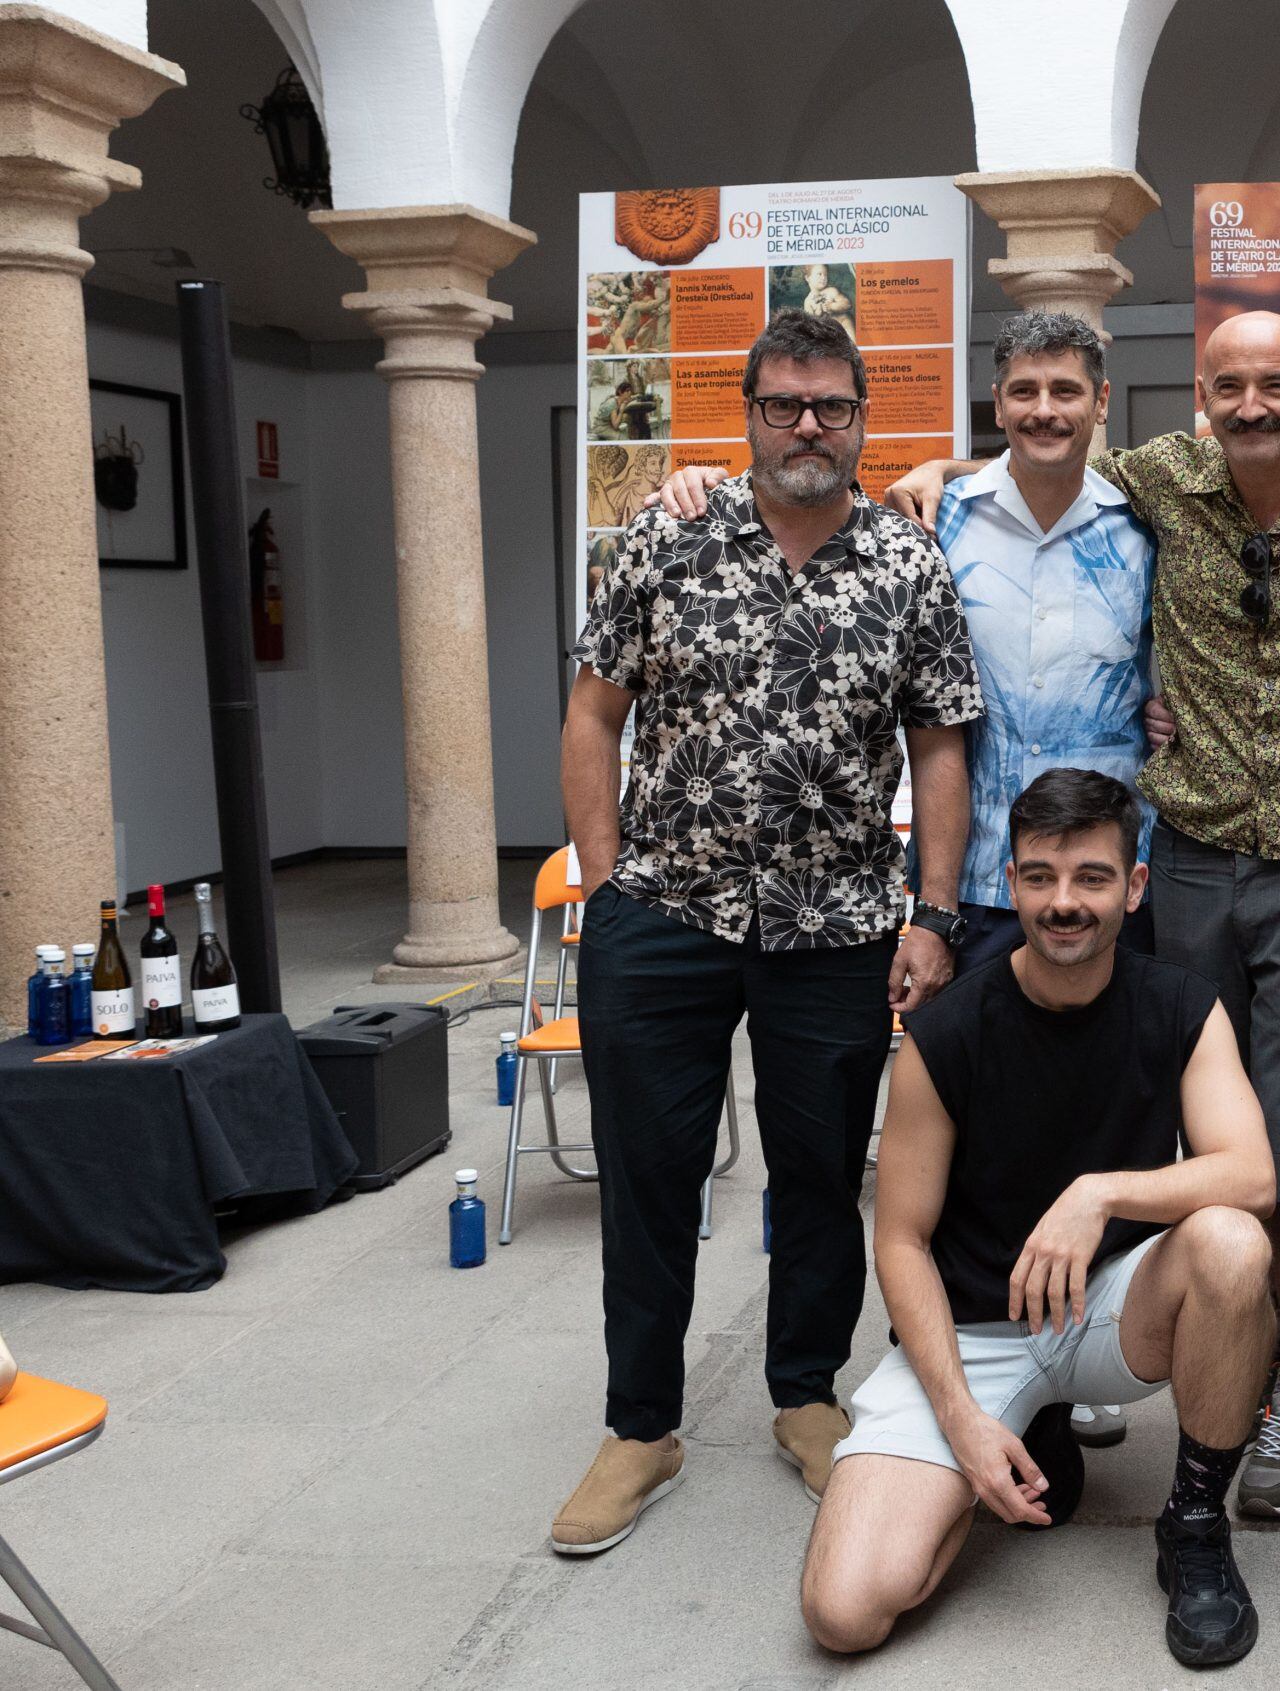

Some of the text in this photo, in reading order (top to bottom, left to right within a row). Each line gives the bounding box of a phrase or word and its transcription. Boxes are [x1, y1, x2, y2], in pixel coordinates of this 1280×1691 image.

[767, 204, 928, 223] FESTIVAL INTERNACIONAL
[1210, 201, 1244, 227] 69
[729, 211, 763, 242] 69
[767, 220, 890, 238] DE TEATRO CLÁSICO
[1210, 228, 1256, 238] FESTIVAL
[767, 237, 864, 253] DE MÉRIDA 2023
[1211, 251, 1224, 261] DE
[1225, 251, 1264, 261] TEATRO
[1211, 262, 1224, 272] DE
[1226, 260, 1265, 272] MÉRIDA
[702, 282, 735, 292] Xenakis,
[861, 276, 919, 289] Los gemelos
[880, 363, 911, 373] titanes
[676, 368, 743, 379] Las asambleíst
[916, 374, 940, 382] dioses
[676, 381, 692, 390] (Las
[694, 382, 708, 390] que
[676, 458, 731, 467] Shakespeare
[861, 461, 913, 471] Pandataria
[97, 1003, 129, 1015] SOLO
[1183, 1512, 1217, 1521] MONARCH
